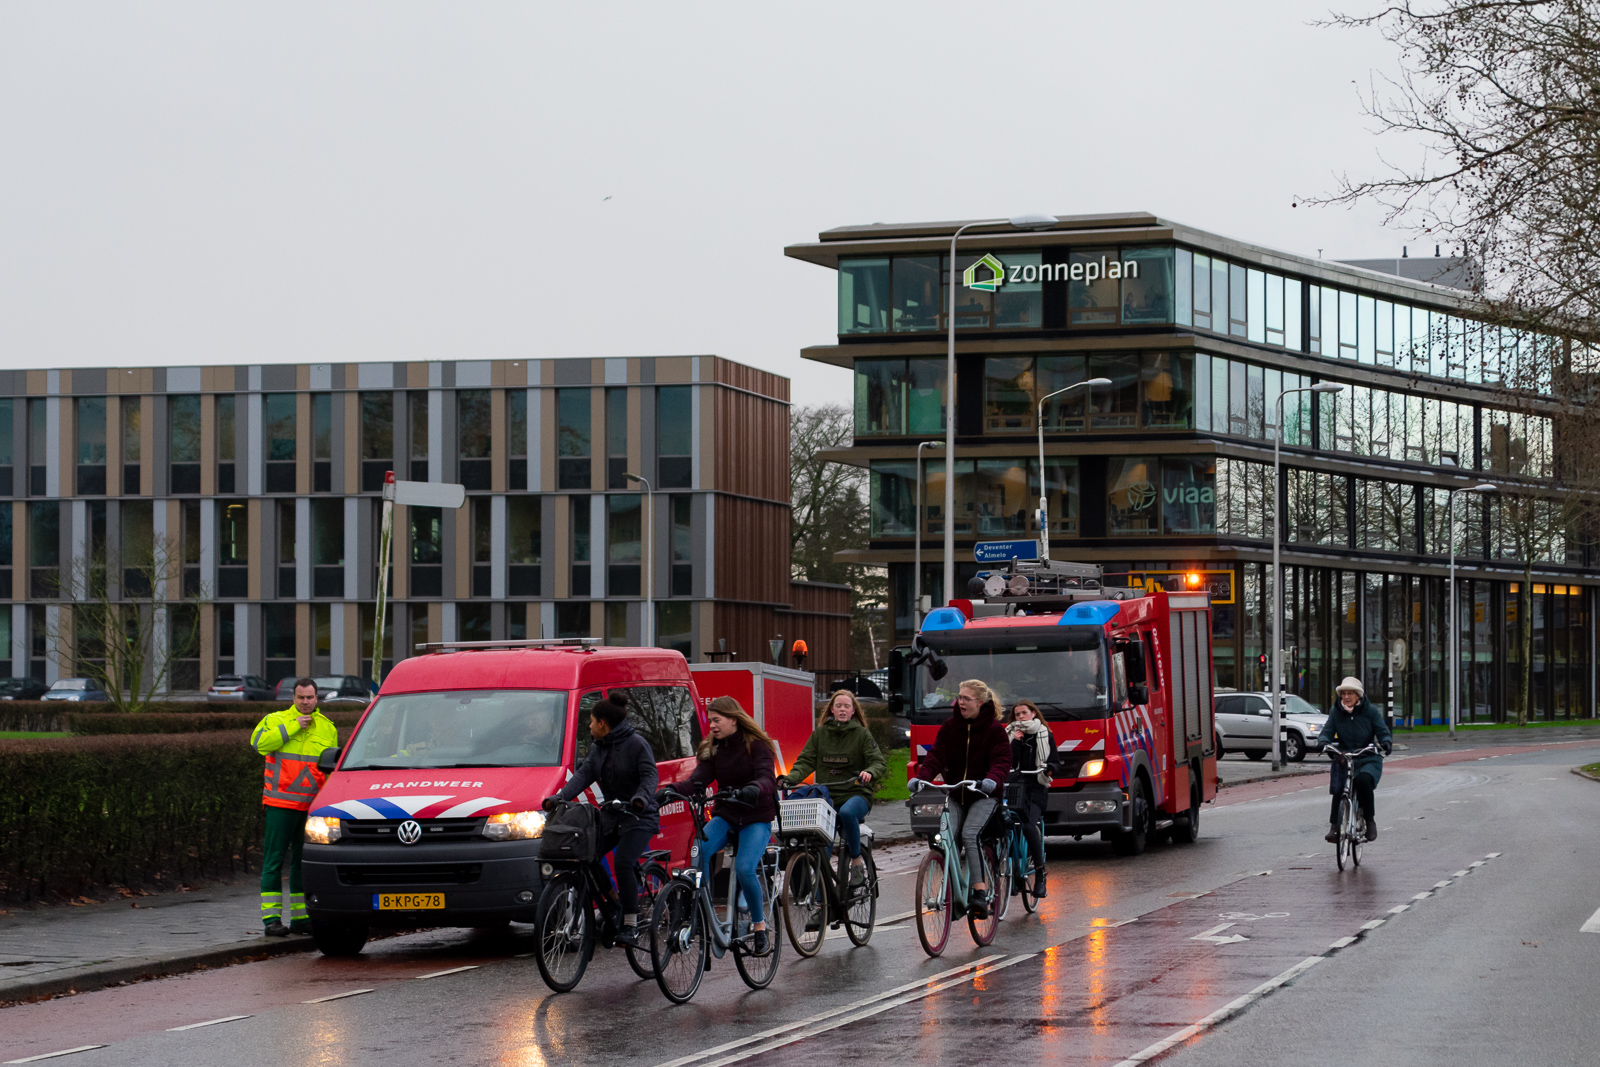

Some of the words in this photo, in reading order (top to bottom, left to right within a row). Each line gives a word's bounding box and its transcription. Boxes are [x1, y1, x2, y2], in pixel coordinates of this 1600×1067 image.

[1009, 255, 1138, 286] zonneplan
[1163, 482, 1214, 504] viaa
[369, 780, 484, 791] BRANDWEER
[382, 894, 441, 908] 8-KPG-78
